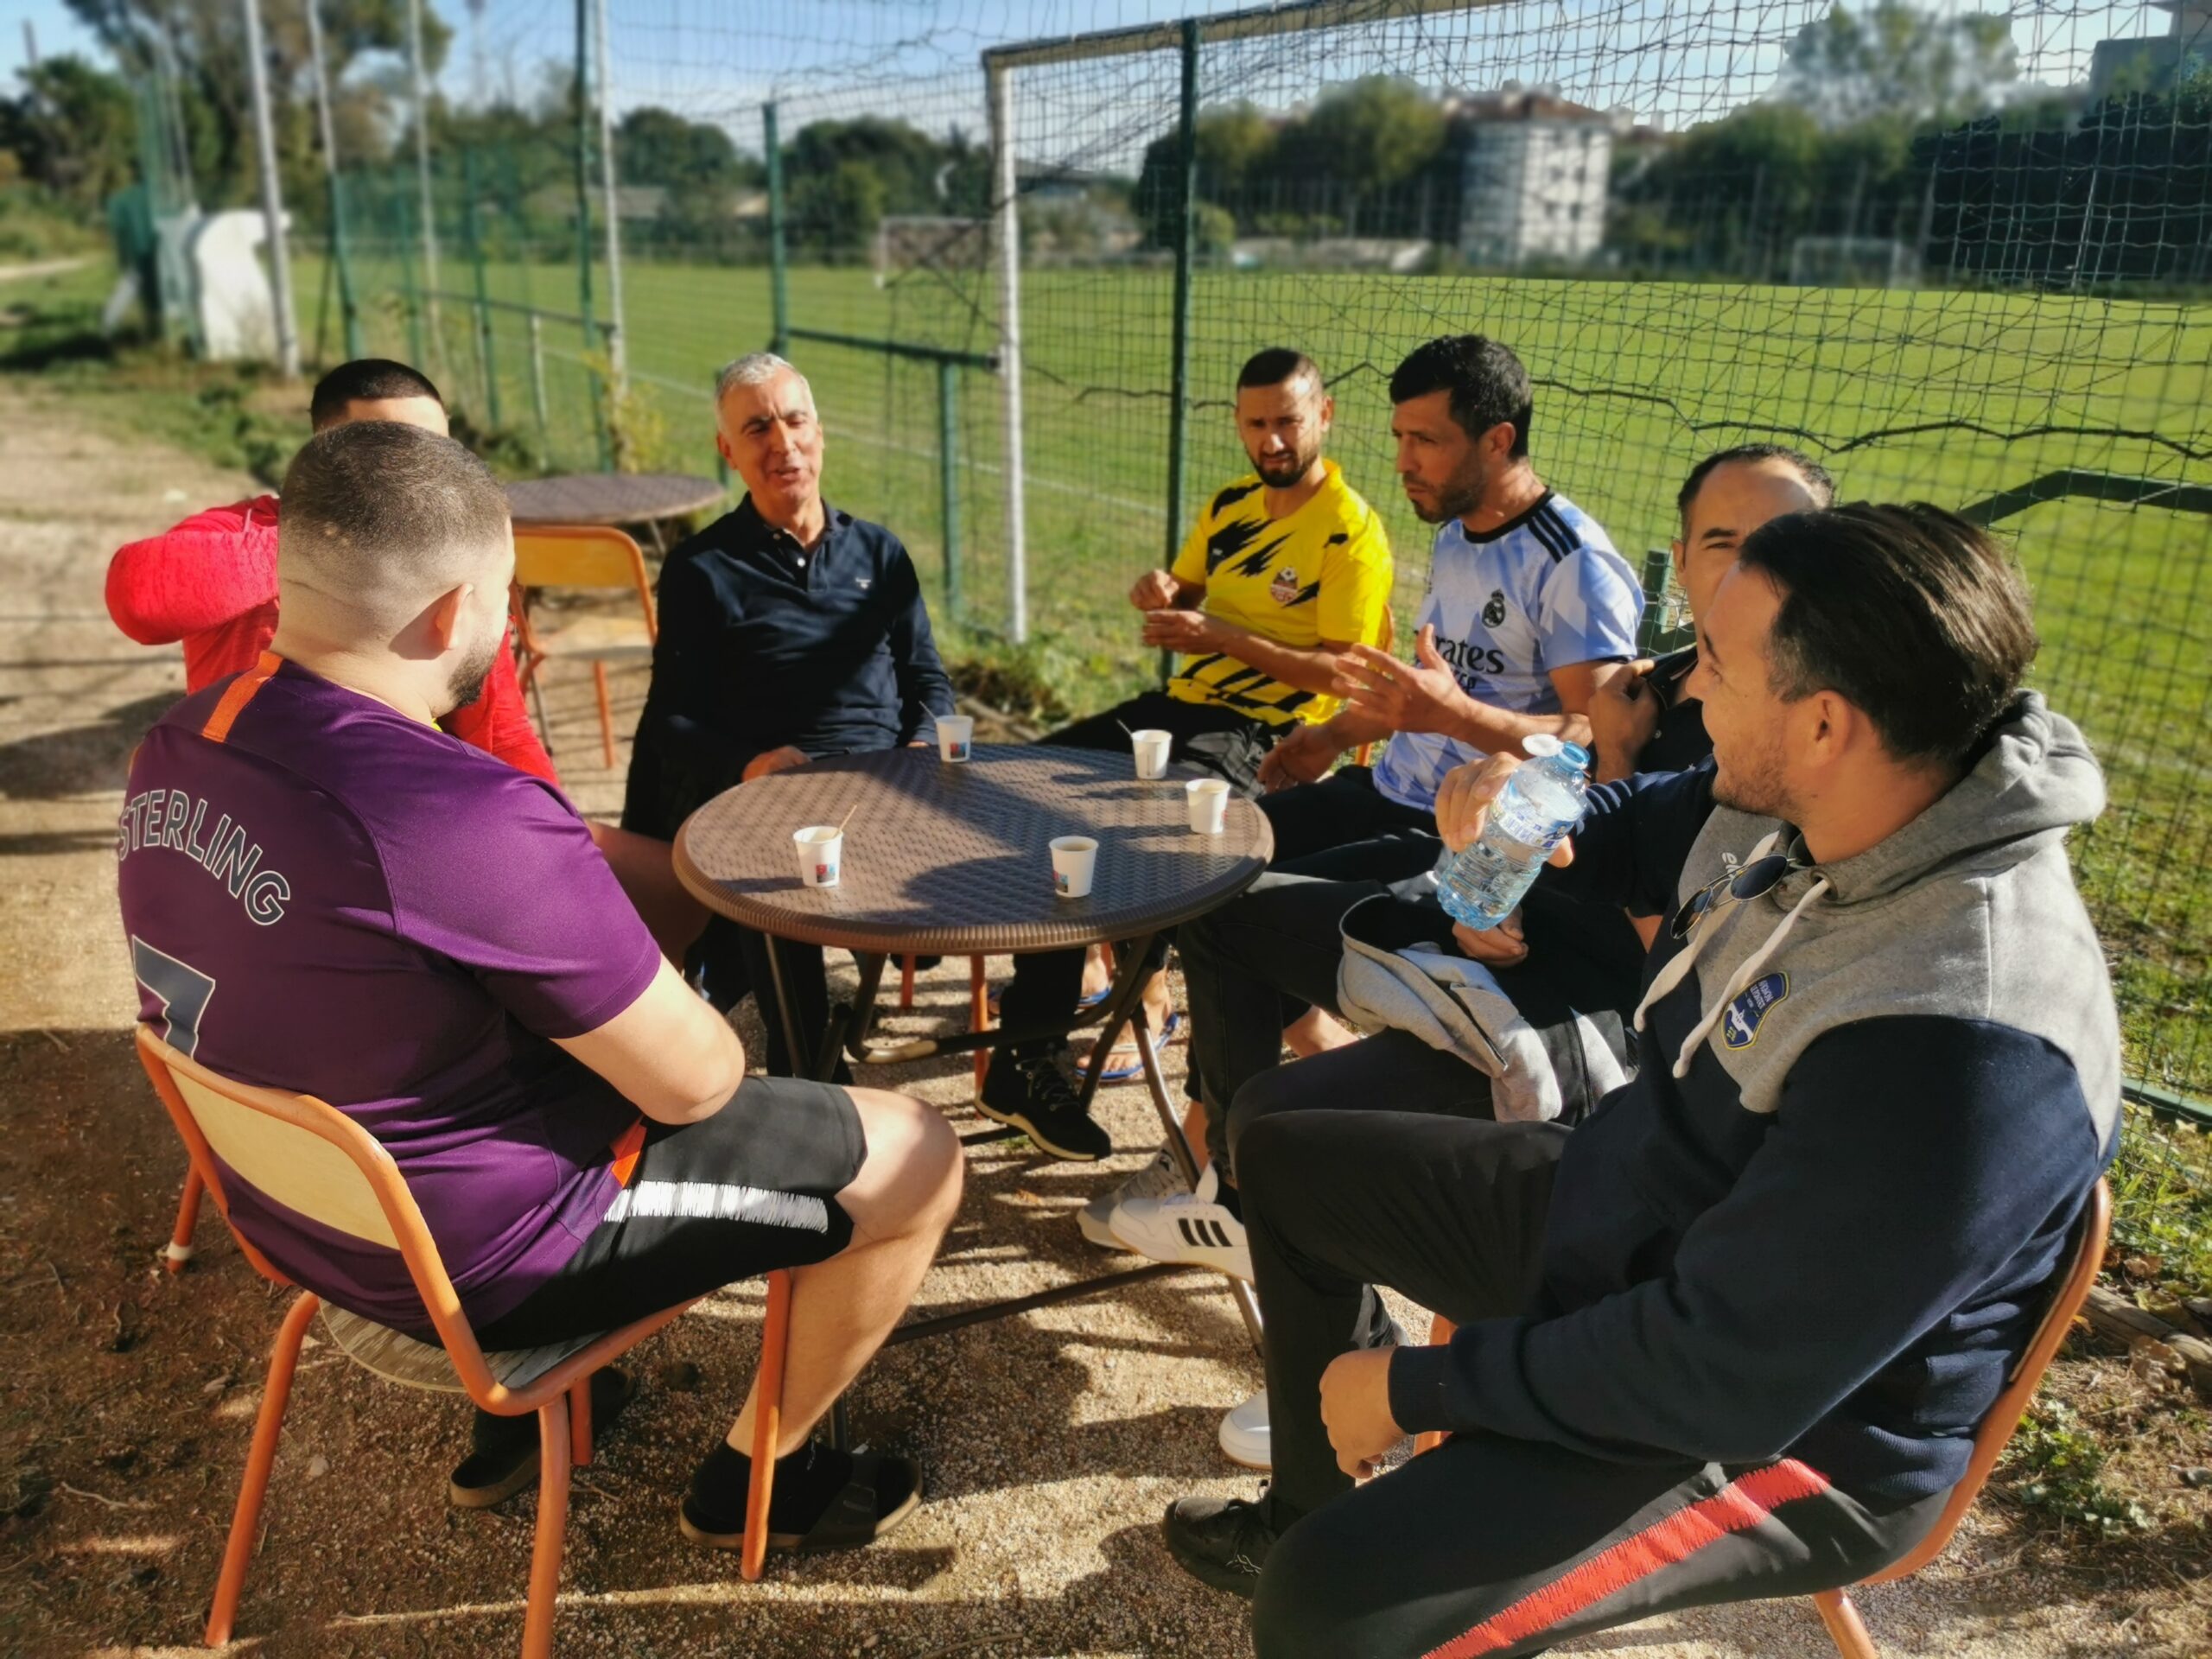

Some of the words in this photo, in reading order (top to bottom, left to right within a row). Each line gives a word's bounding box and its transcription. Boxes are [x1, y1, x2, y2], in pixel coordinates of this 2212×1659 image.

[1414, 630, 1504, 674] rates
[118, 789, 290, 925] STERLING
[131, 934, 216, 1059] 7
